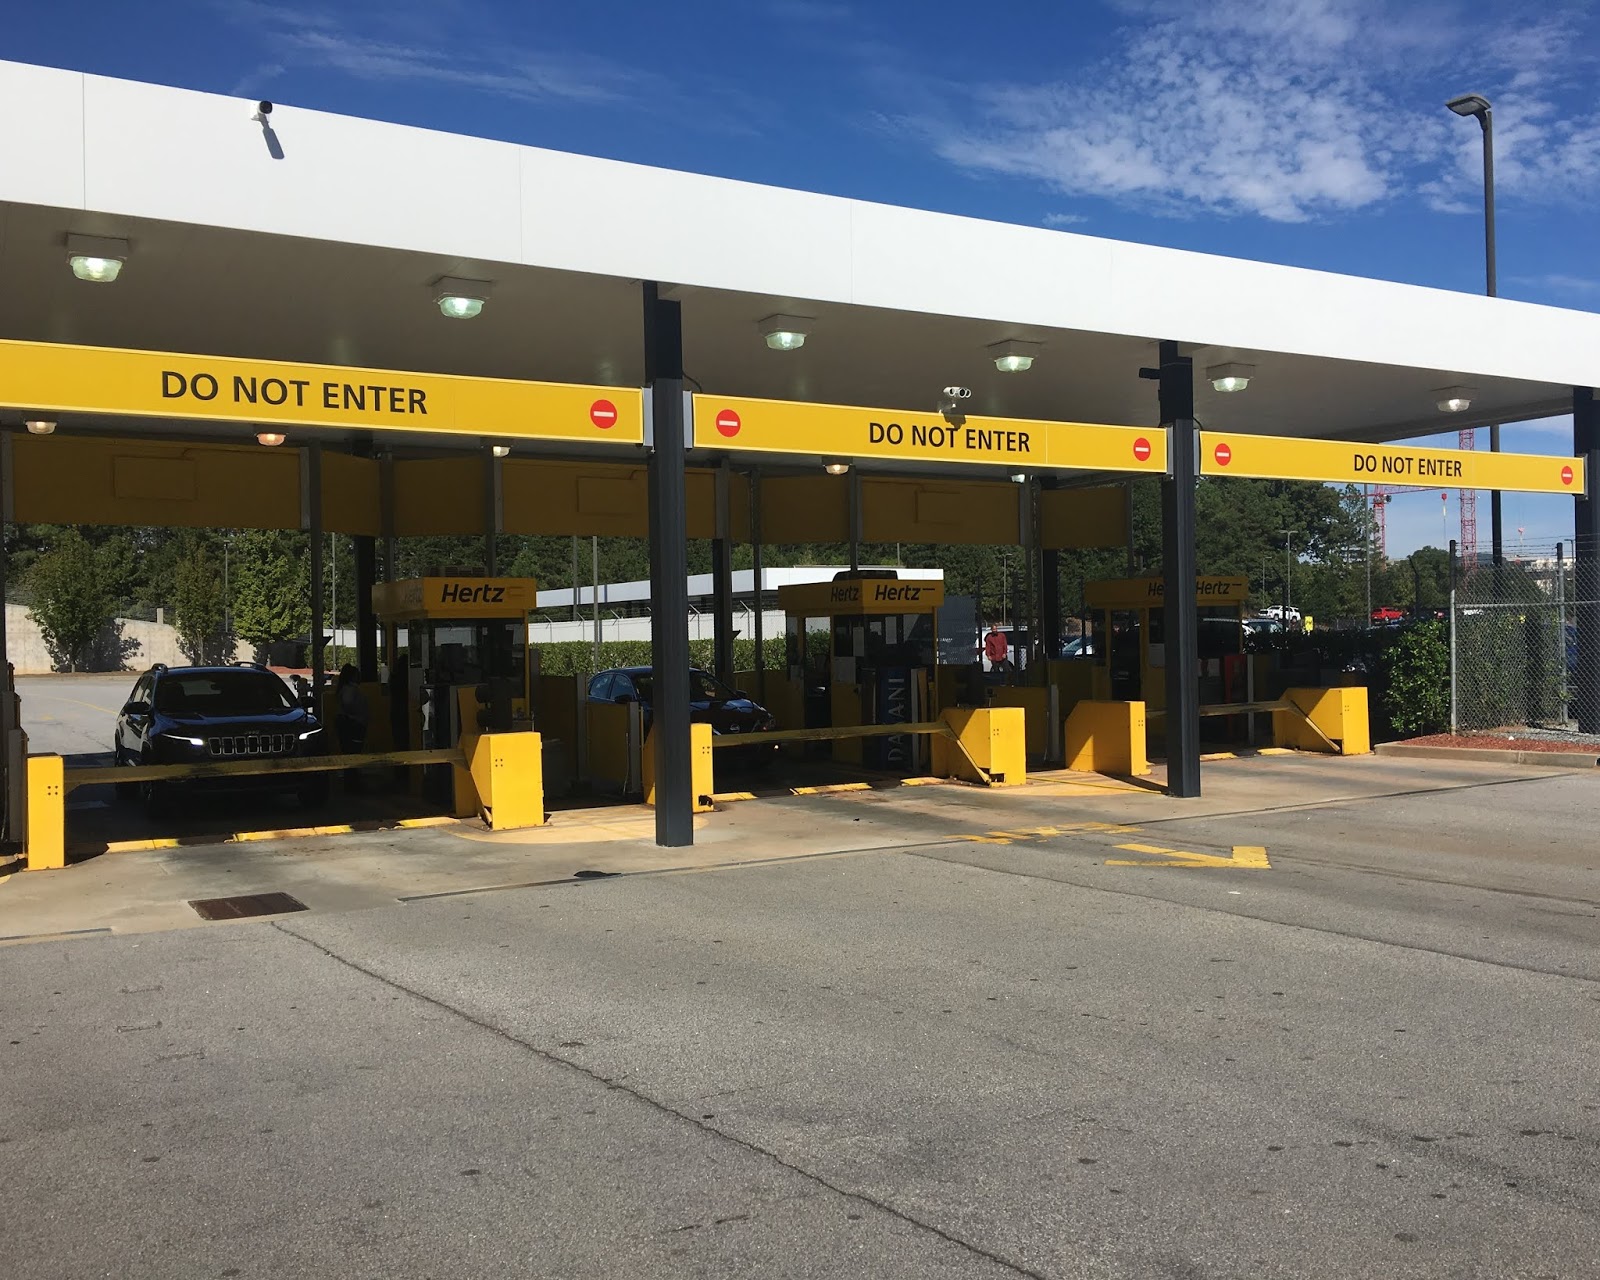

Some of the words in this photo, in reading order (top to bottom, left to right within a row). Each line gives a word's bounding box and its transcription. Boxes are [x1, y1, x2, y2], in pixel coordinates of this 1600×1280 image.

[161, 370, 219, 401] DO
[233, 376, 310, 407] NOT
[323, 382, 428, 415] ENTER
[869, 422, 904, 445] DO
[912, 425, 959, 448] NOT
[966, 428, 1031, 453] ENTER
[1354, 454, 1377, 473] DO
[1382, 456, 1414, 475] NOT
[1418, 458, 1463, 478] ENTER
[441, 583, 506, 603] Hertz
[830, 585, 860, 602] Hertz
[874, 584, 921, 601] Hertz
[1196, 581, 1231, 595] Hertz
[887, 678, 905, 762] DAANI
